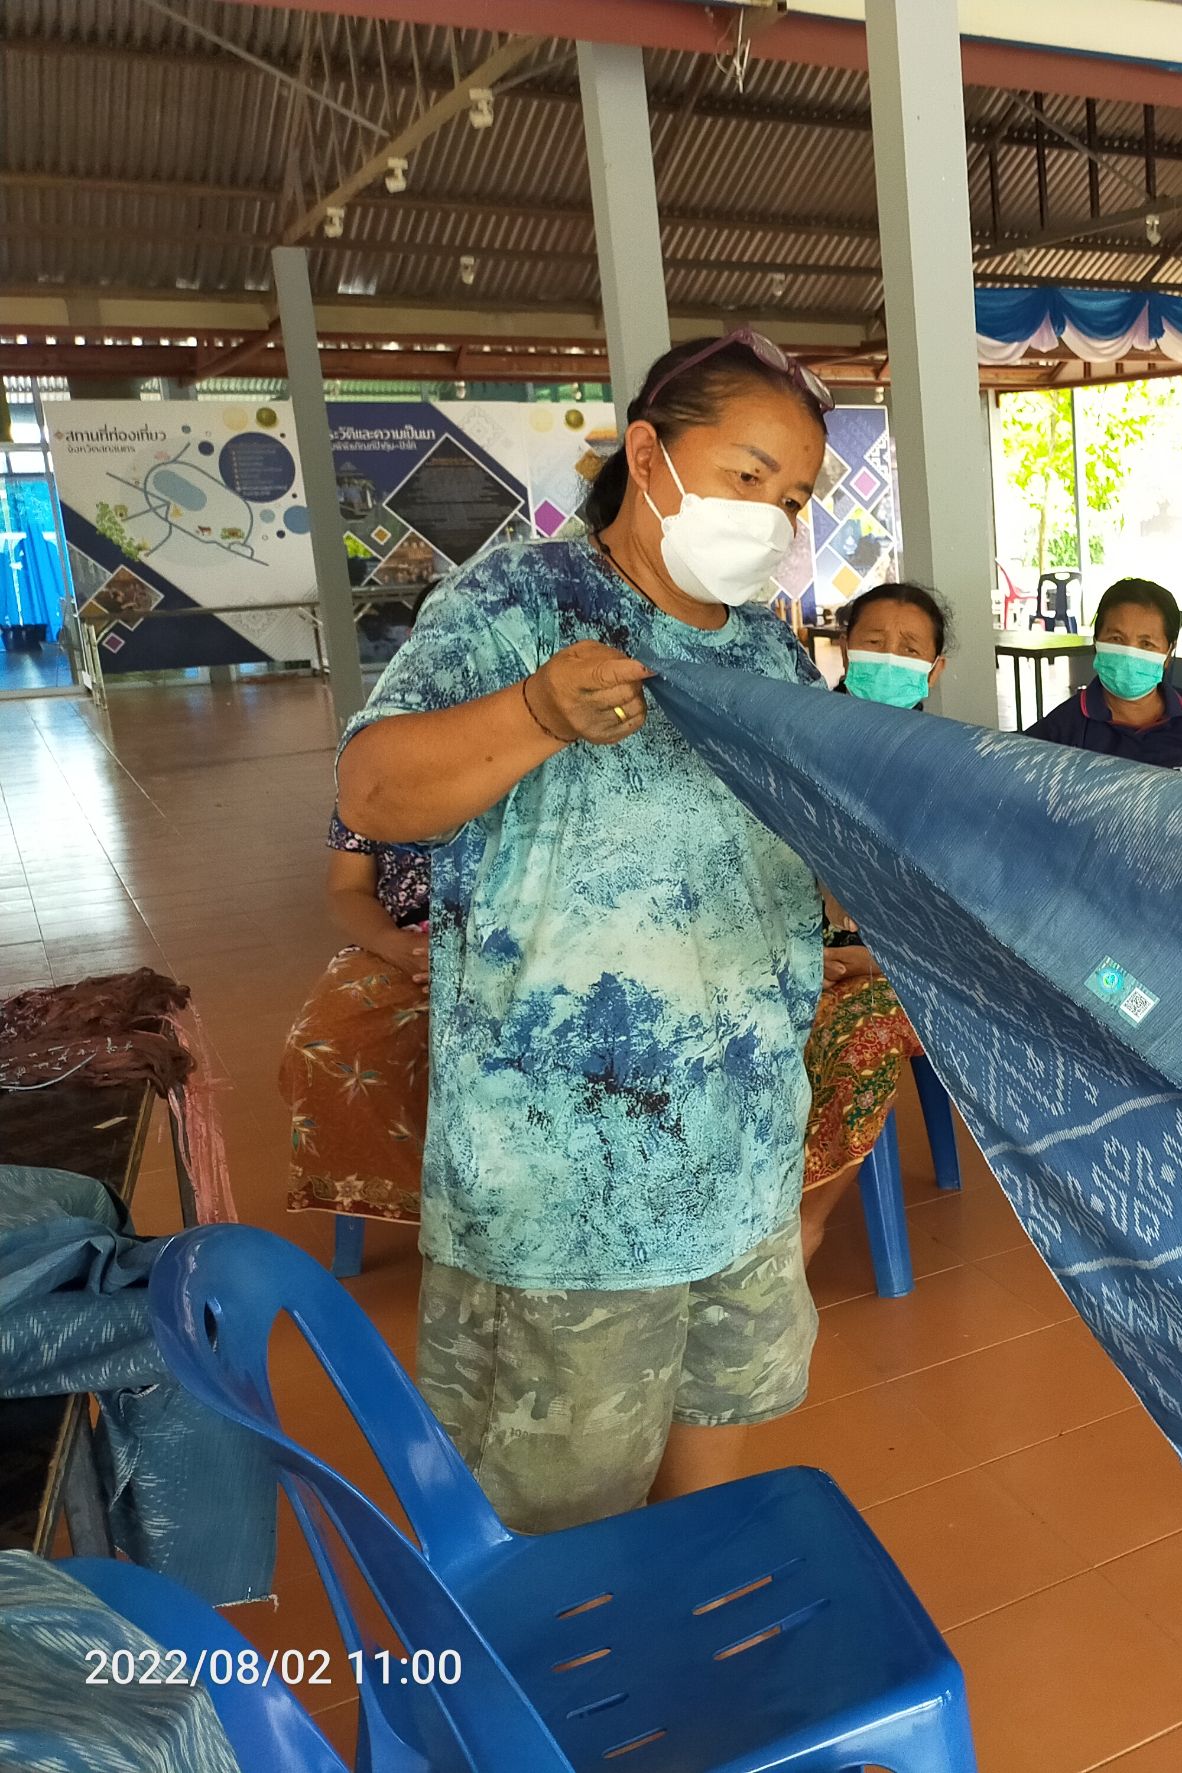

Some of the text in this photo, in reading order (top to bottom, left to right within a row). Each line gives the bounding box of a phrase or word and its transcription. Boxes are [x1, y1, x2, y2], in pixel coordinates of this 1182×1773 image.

[65, 423, 167, 442] สถานที่ท่องเที่ยว
